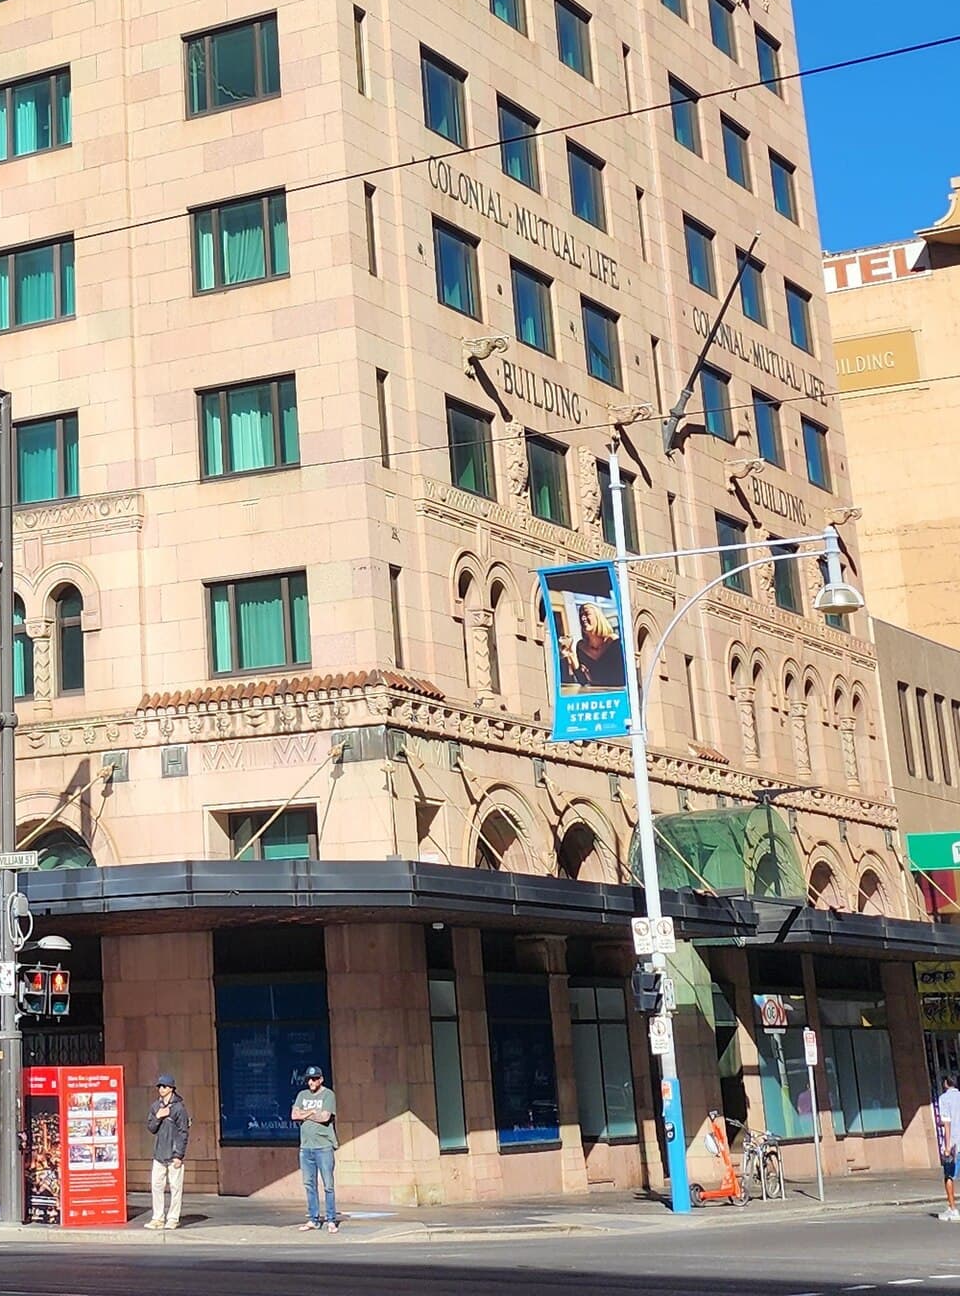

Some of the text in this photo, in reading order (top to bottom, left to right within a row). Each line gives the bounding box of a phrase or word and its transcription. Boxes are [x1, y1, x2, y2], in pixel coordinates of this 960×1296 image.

[427, 155, 620, 291] COLONIAL MUTUAL LIFE
[501, 358, 582, 424] BUILDING
[751, 339, 802, 392] MUTUAL
[801, 368, 828, 407] LIFE
[751, 475, 807, 527] BUILDING
[566, 698, 621, 712] HINDLEY
[569, 710, 617, 722] STREET
[24, 855, 33, 864] ST
